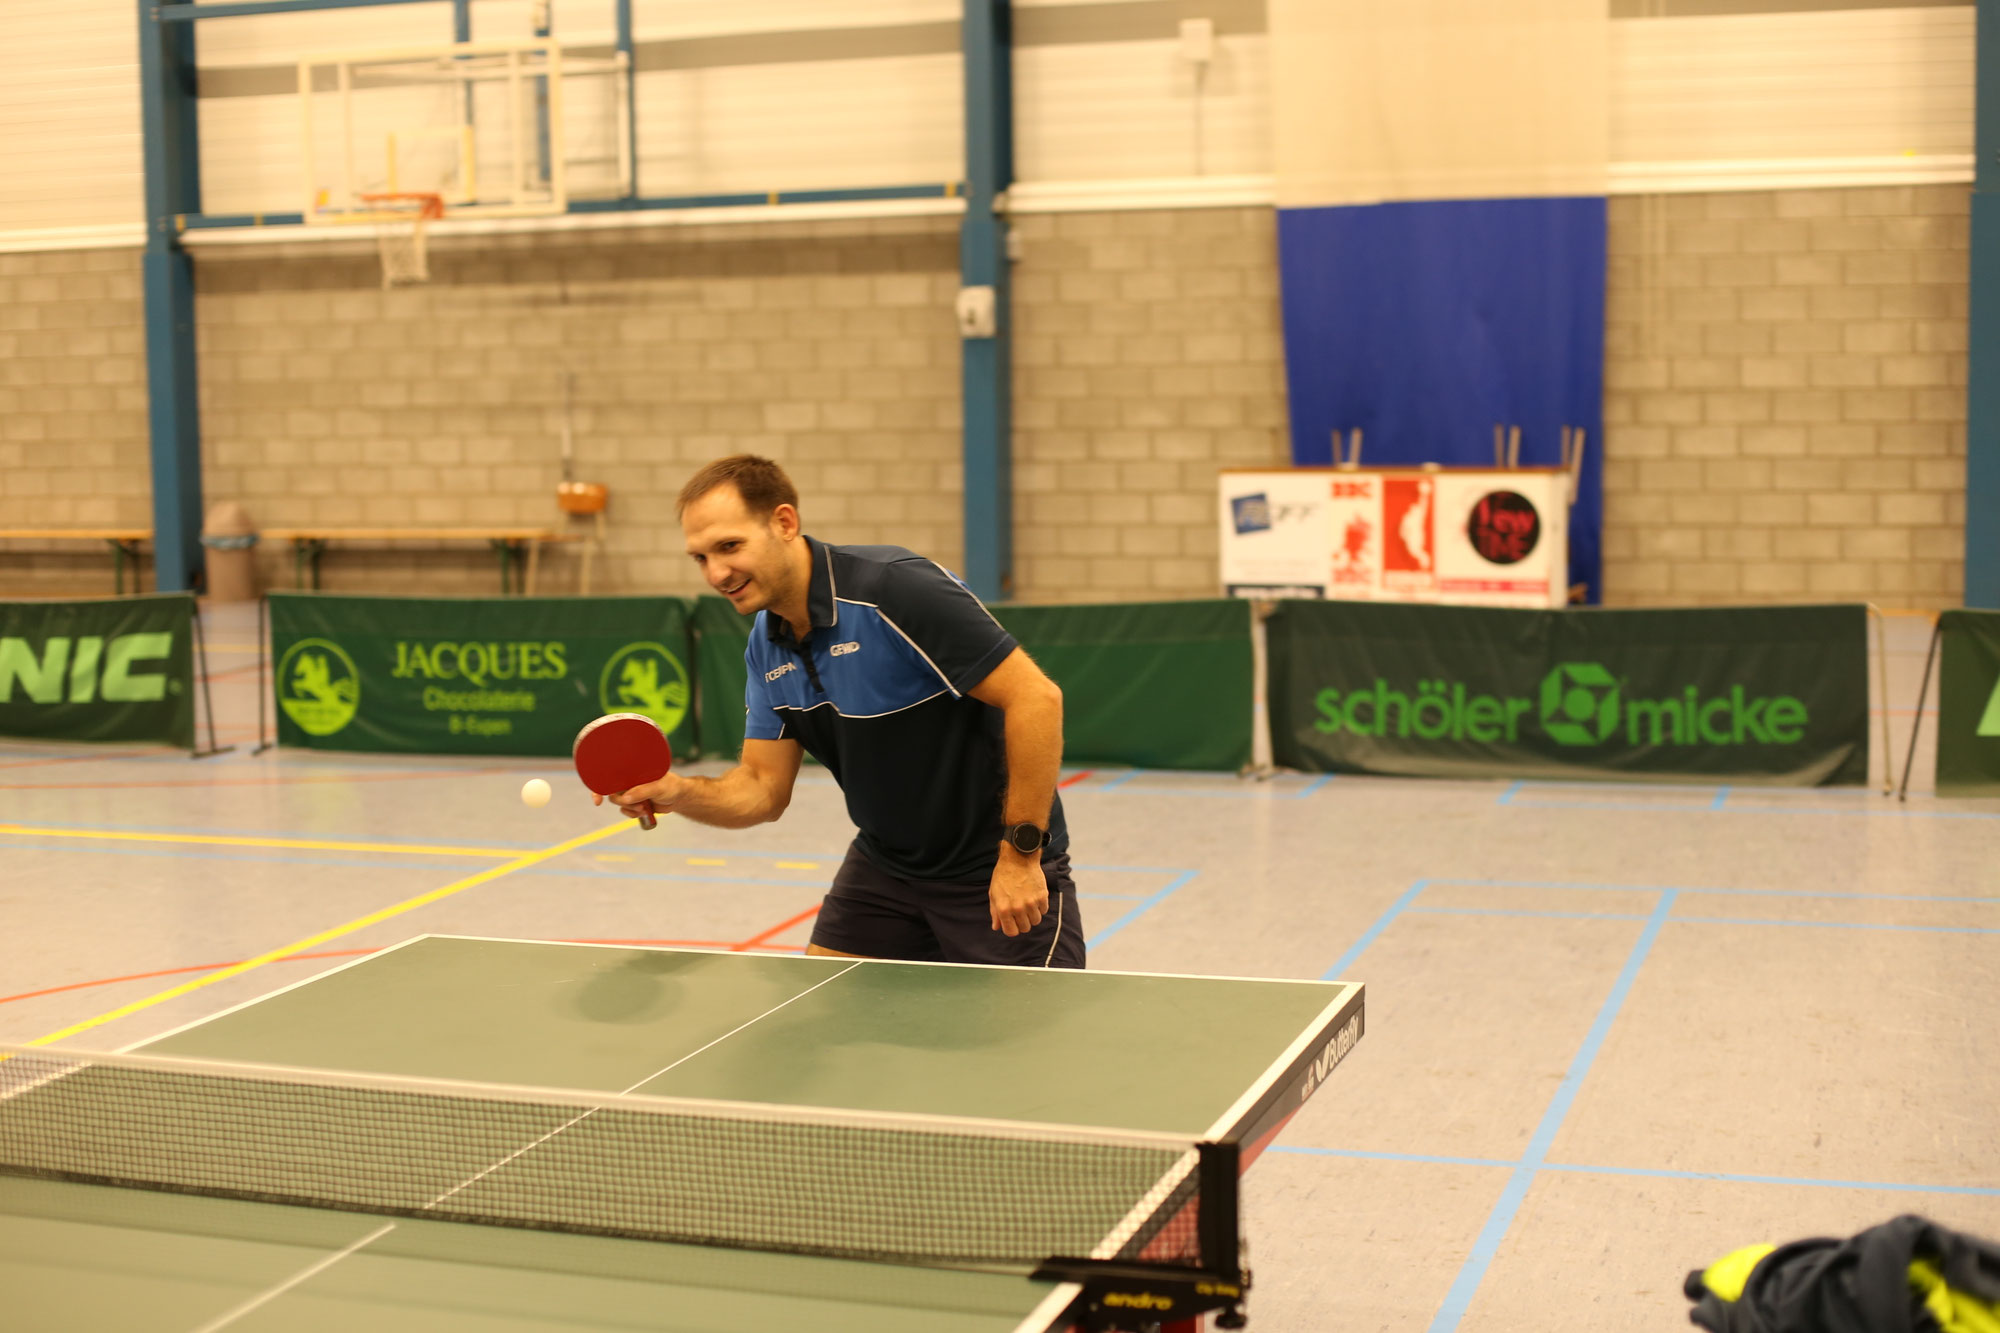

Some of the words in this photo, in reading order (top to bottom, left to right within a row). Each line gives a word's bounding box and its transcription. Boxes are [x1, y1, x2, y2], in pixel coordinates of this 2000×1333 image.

[393, 642, 567, 686] JACQUES
[1315, 680, 1531, 742] schöler
[1627, 685, 1808, 746] micke
[1329, 1014, 1359, 1070] Butterfly
[1103, 1291, 1174, 1311] andro
